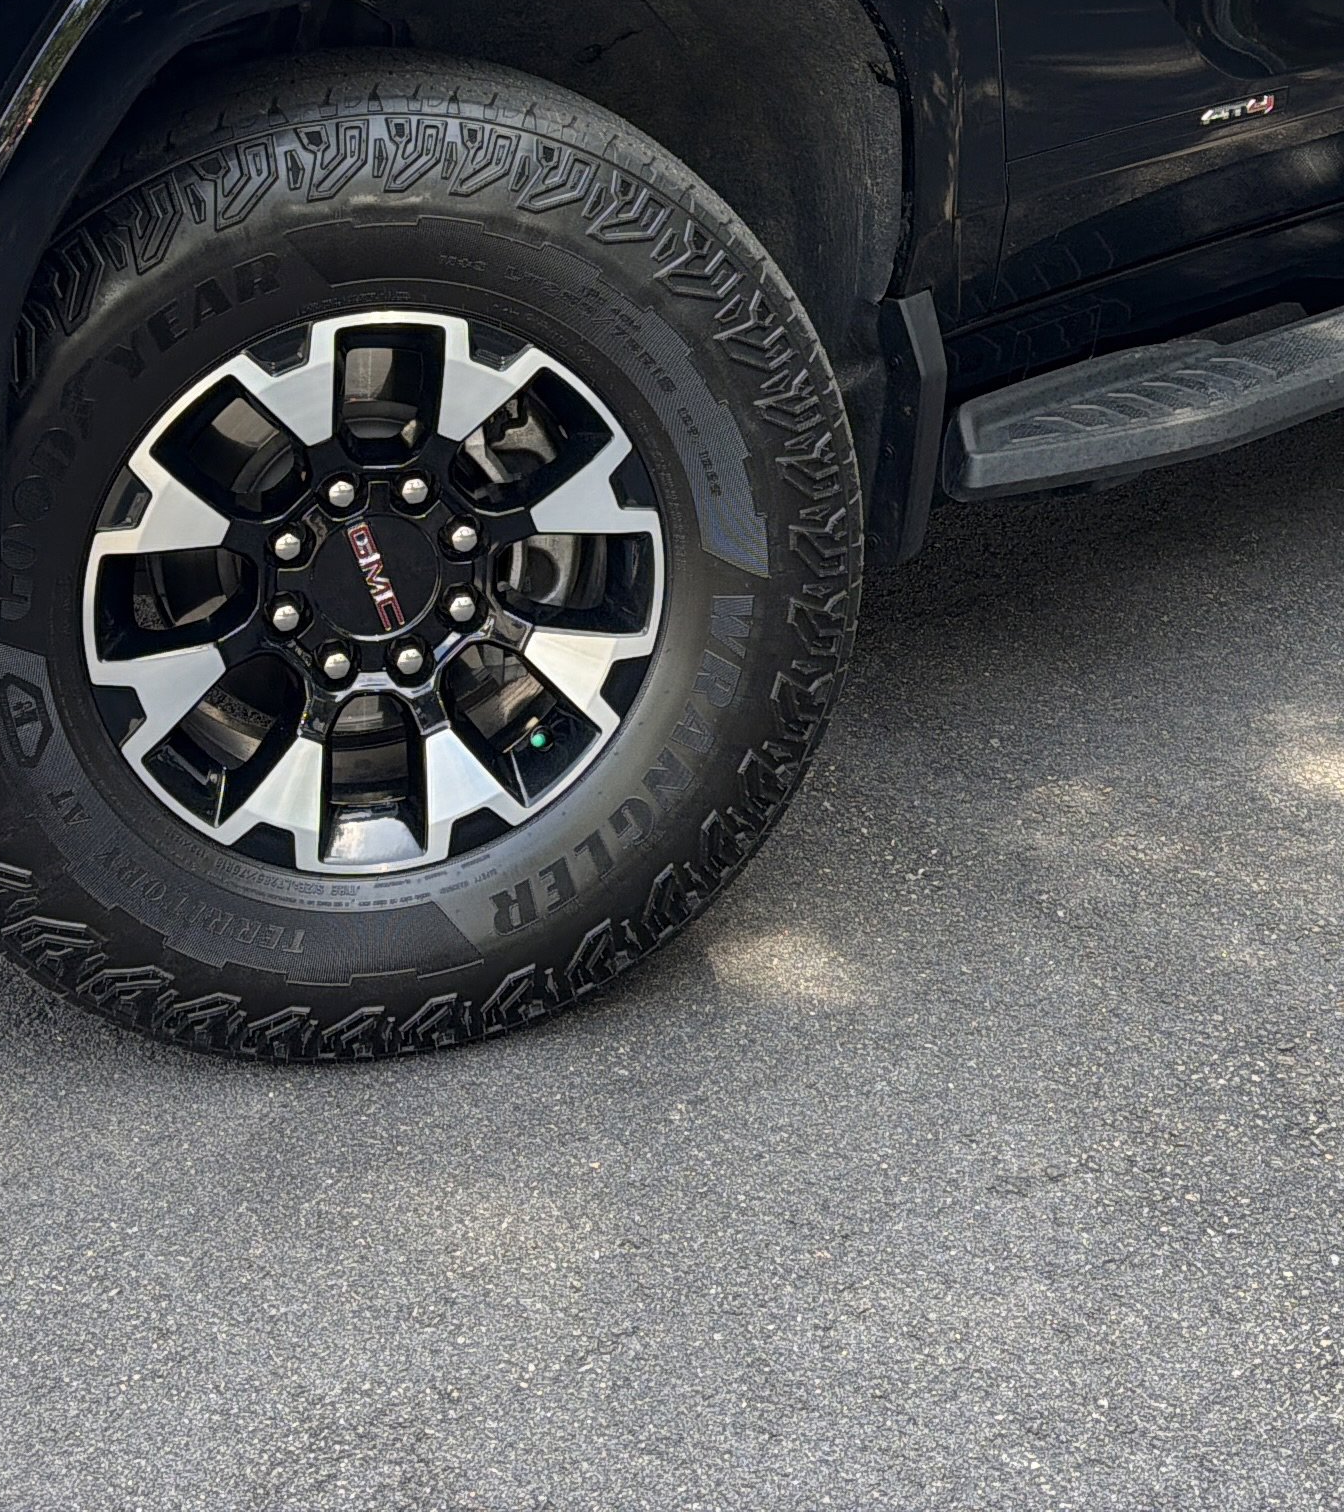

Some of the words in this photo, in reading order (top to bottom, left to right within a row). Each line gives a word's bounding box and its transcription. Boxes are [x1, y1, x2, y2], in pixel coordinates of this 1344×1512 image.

[1200, 94, 1275, 126] AT4
[346, 520, 406, 632] GMC
[488, 593, 756, 937] WRANGLER
[92, 847, 307, 955] TERRITORY
